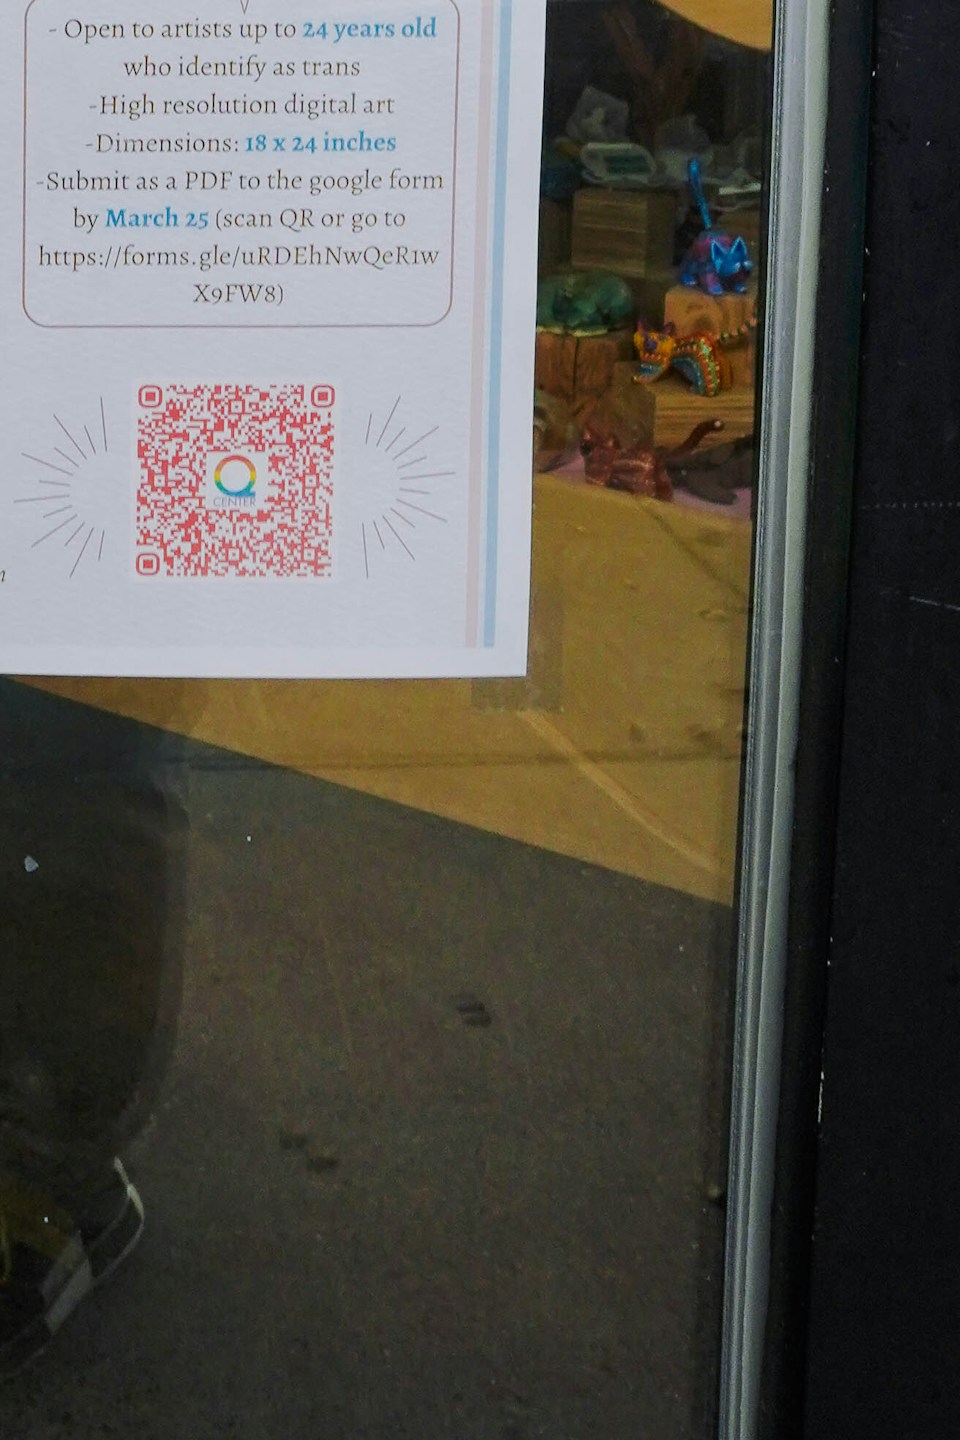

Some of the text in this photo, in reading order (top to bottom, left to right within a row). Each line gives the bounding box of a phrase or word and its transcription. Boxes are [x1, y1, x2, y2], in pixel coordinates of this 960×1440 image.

[64, 18, 125, 45] Open
[131, 22, 155, 39] to
[160, 17, 232, 39] artists
[239, 23, 268, 45] up
[274, 21, 297, 39] to
[302, 21, 329, 41] 24
[333, 22, 396, 44] years
[401, 15, 437, 39] old
[123, 53, 361, 83] who identify as trans
[163, 92, 278, 115] resolution
[284, 92, 357, 121] digital
[363, 97, 395, 114] art
[245, 133, 267, 153] 18
[272, 136, 287, 153] x
[291, 135, 318, 155] 24
[323, 129, 397, 153] inches
[135, 175, 159, 191] as
[165, 175, 177, 191] a
[185, 170, 233, 191] PDF
[238, 174, 261, 190] to
[266, 168, 303, 190] the
[309, 168, 383, 197] google
[389, 168, 444, 190] form
[73, 205, 406, 234] by March 25 (scan QR or go to
[192, 283, 284, 306] X9FW8)
[213, 497, 256, 507] CENTER
